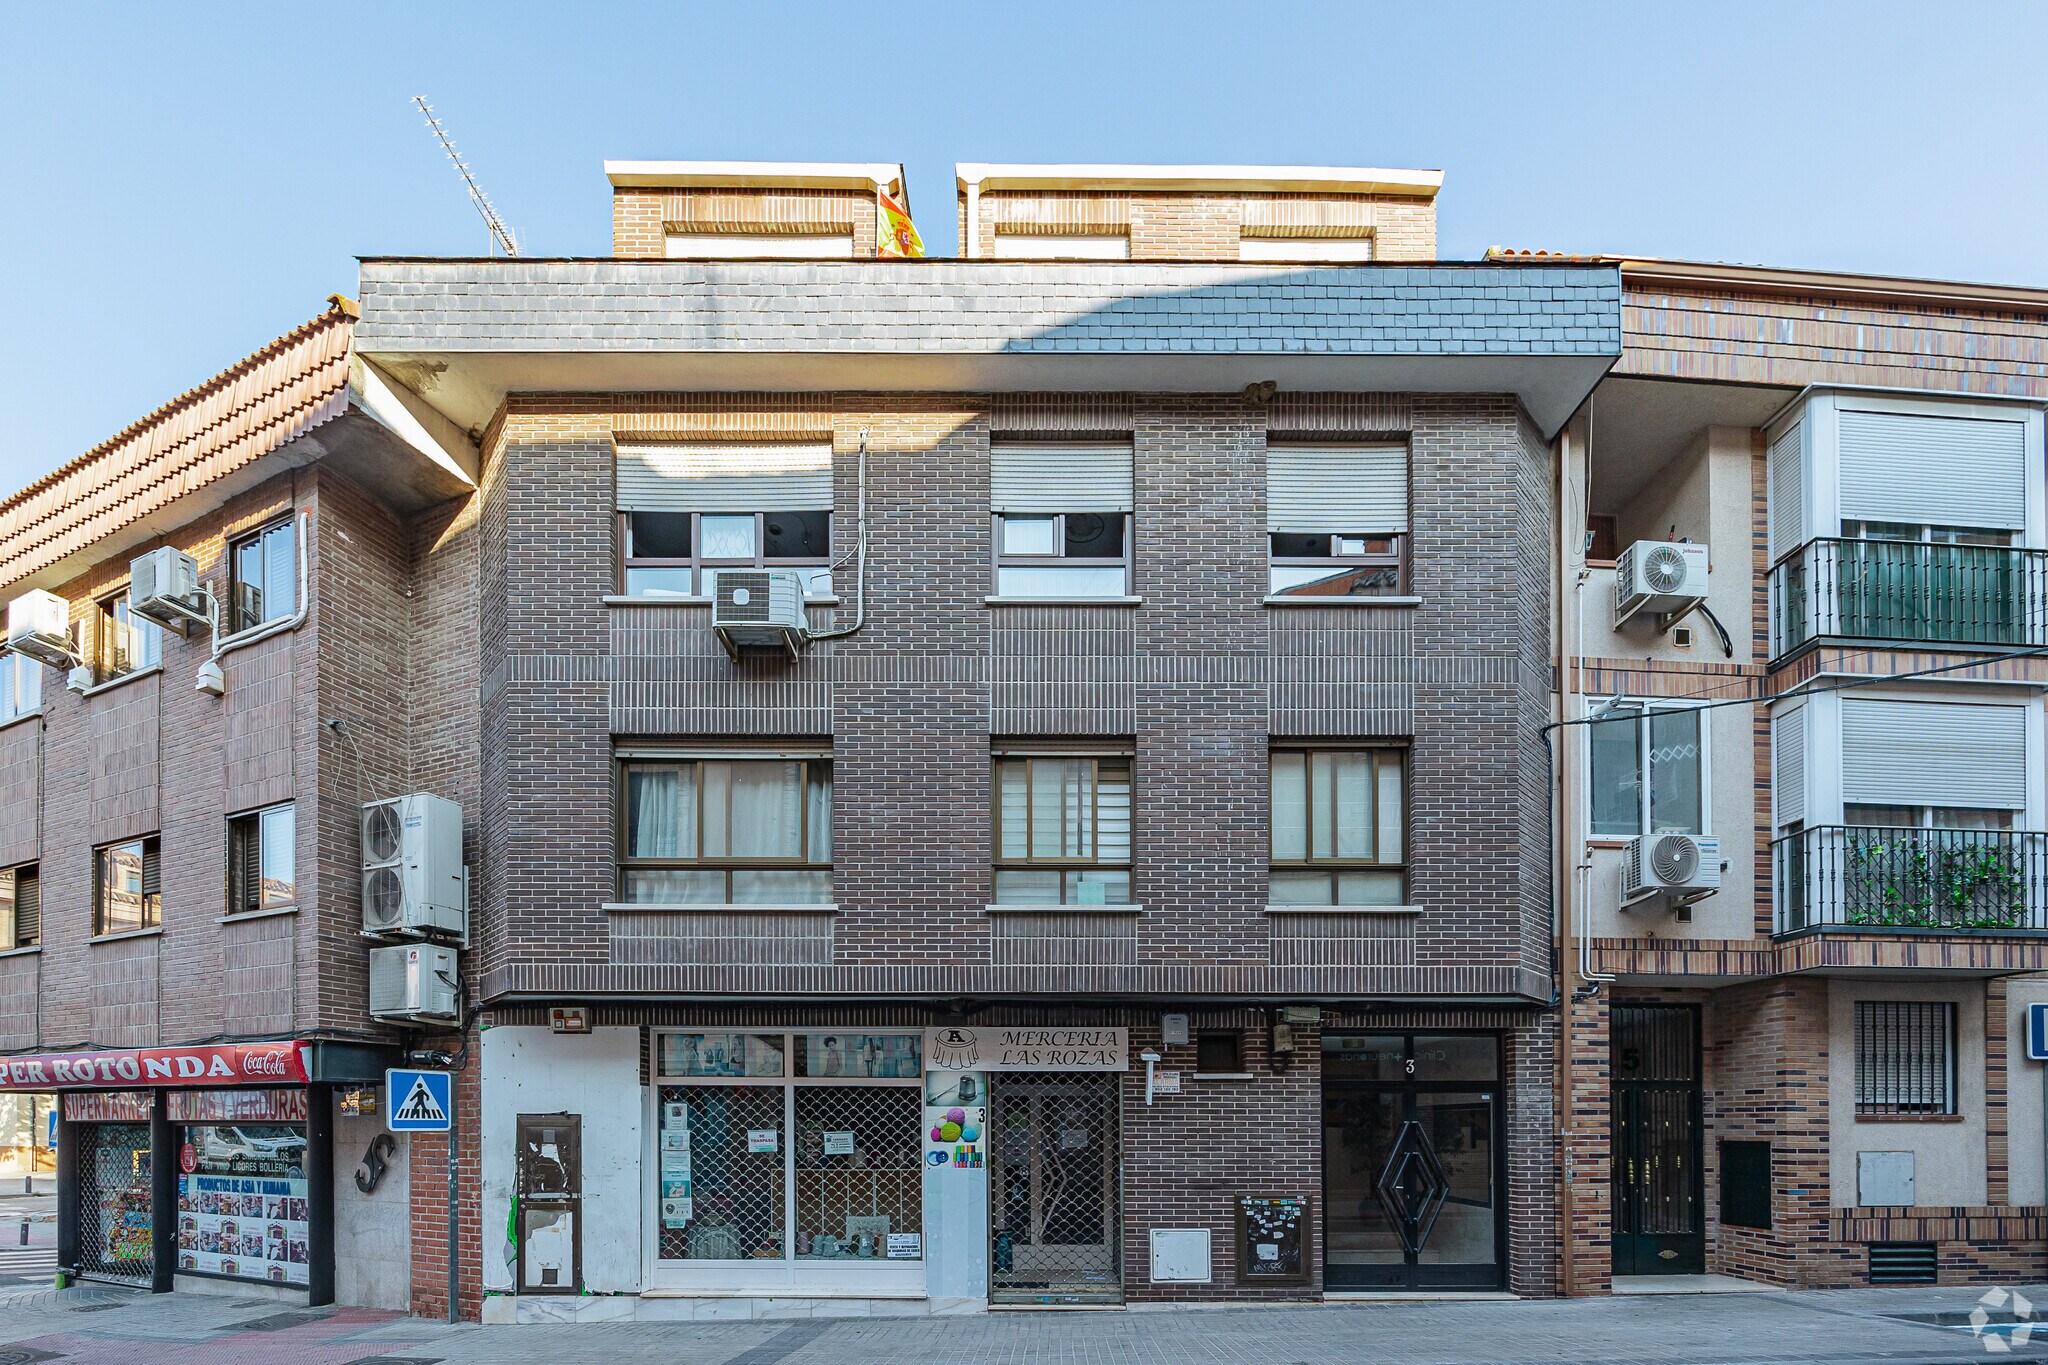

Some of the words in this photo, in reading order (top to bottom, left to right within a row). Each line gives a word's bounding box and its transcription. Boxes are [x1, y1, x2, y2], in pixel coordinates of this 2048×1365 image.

[948, 1030, 965, 1042] A
[1000, 1031, 1118, 1047] MERCERIA
[243, 1050, 286, 1076] Coca-Cola
[1000, 1050, 1040, 1065] LAS
[1047, 1050, 1118, 1065] ROZAS
[1623, 1048, 1640, 1071] 5
[1406, 1060, 1415, 1073] 3
[64, 1092, 151, 1120] SUPERMARKET
[167, 1091, 216, 1120] FRUTAS
[231, 1089, 308, 1120] VERDURAS
[978, 1108, 985, 1123] 3
[233, 1161, 257, 1172] LICORES
[197, 1177, 231, 1192] PRODUCTOS
